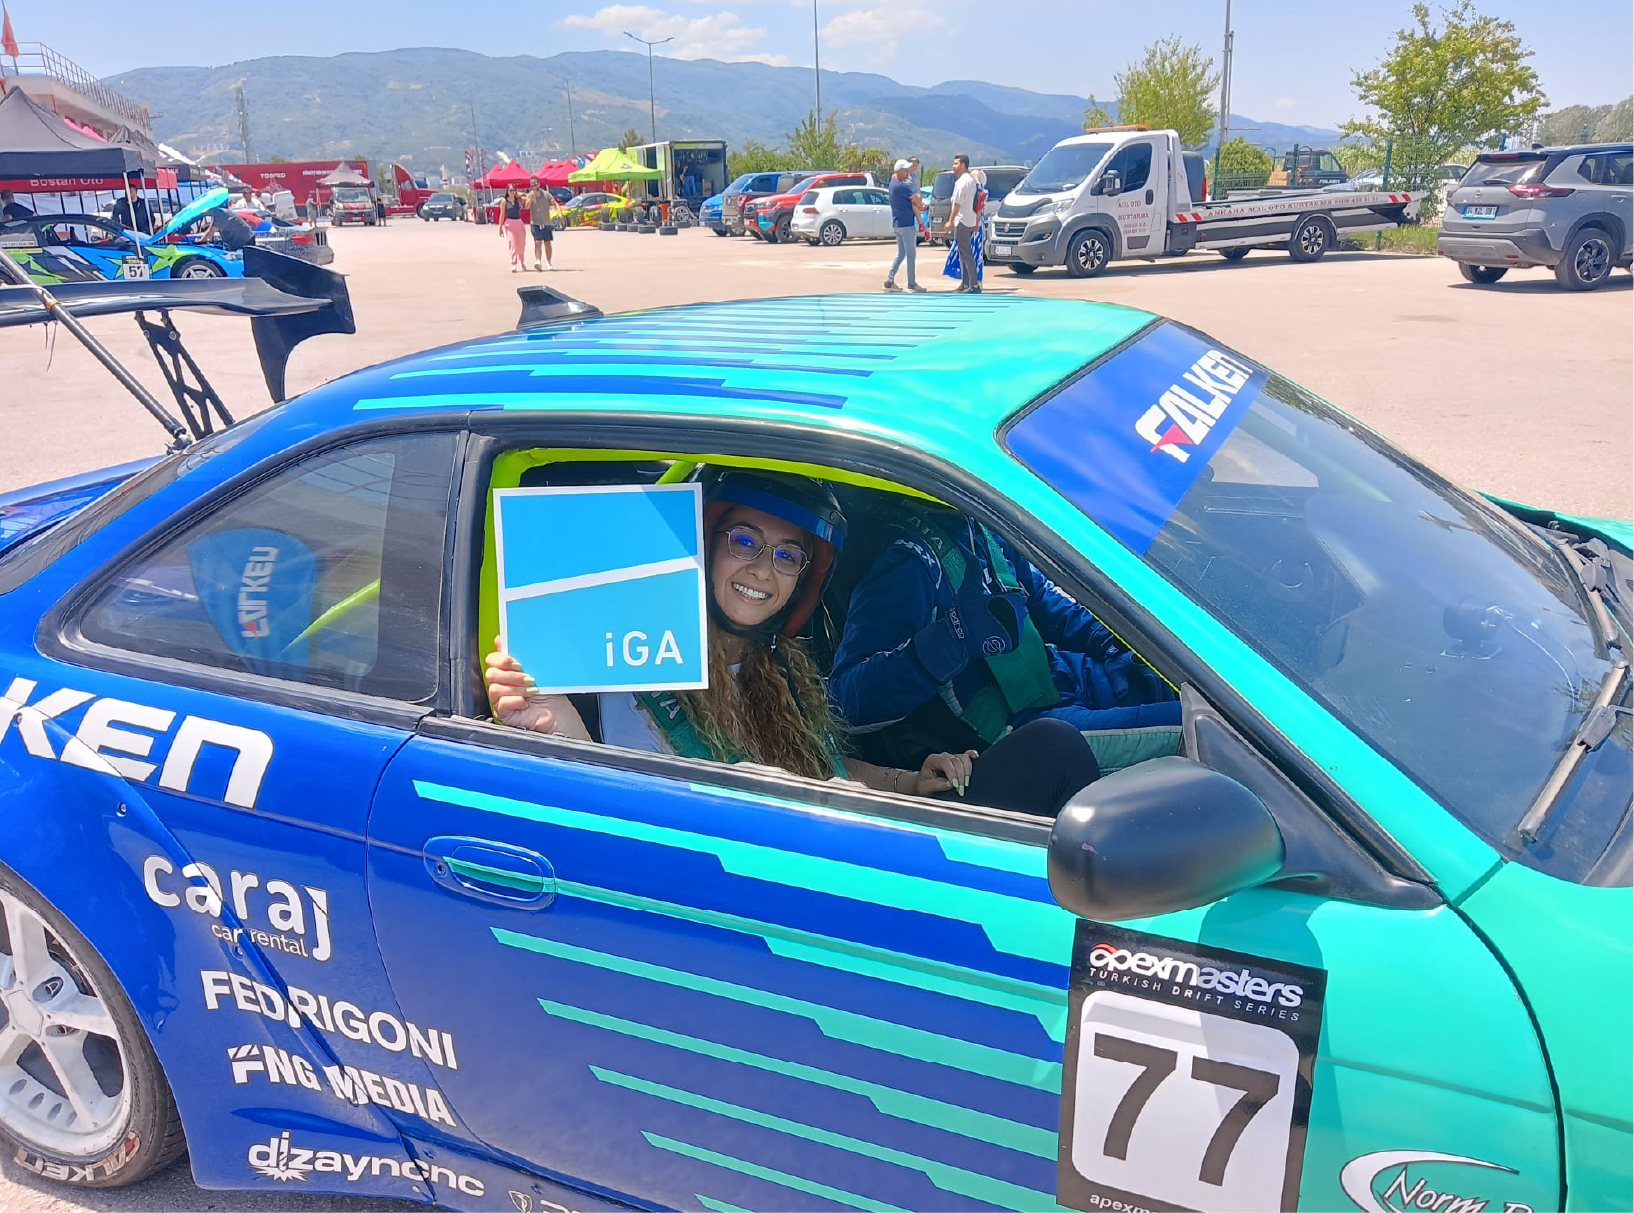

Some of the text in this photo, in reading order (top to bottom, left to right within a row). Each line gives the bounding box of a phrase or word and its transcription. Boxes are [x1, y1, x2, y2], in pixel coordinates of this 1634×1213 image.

[1208, 209, 1246, 217] ANKARA
[1268, 203, 1286, 211] OTO
[1287, 200, 1332, 209] KURTARMA
[1134, 349, 1254, 464] FALKEN
[142, 854, 332, 962] caraj
[210, 921, 309, 958] car rental
[1088, 943, 1305, 1008] apexmasters
[1089, 967, 1301, 1022] TURKISH DRIFT SERIES
[200, 969, 459, 1071] FEDRIGONI
[322, 1064, 458, 1128] MEDIA
[1093, 1032, 1282, 1187] 77
